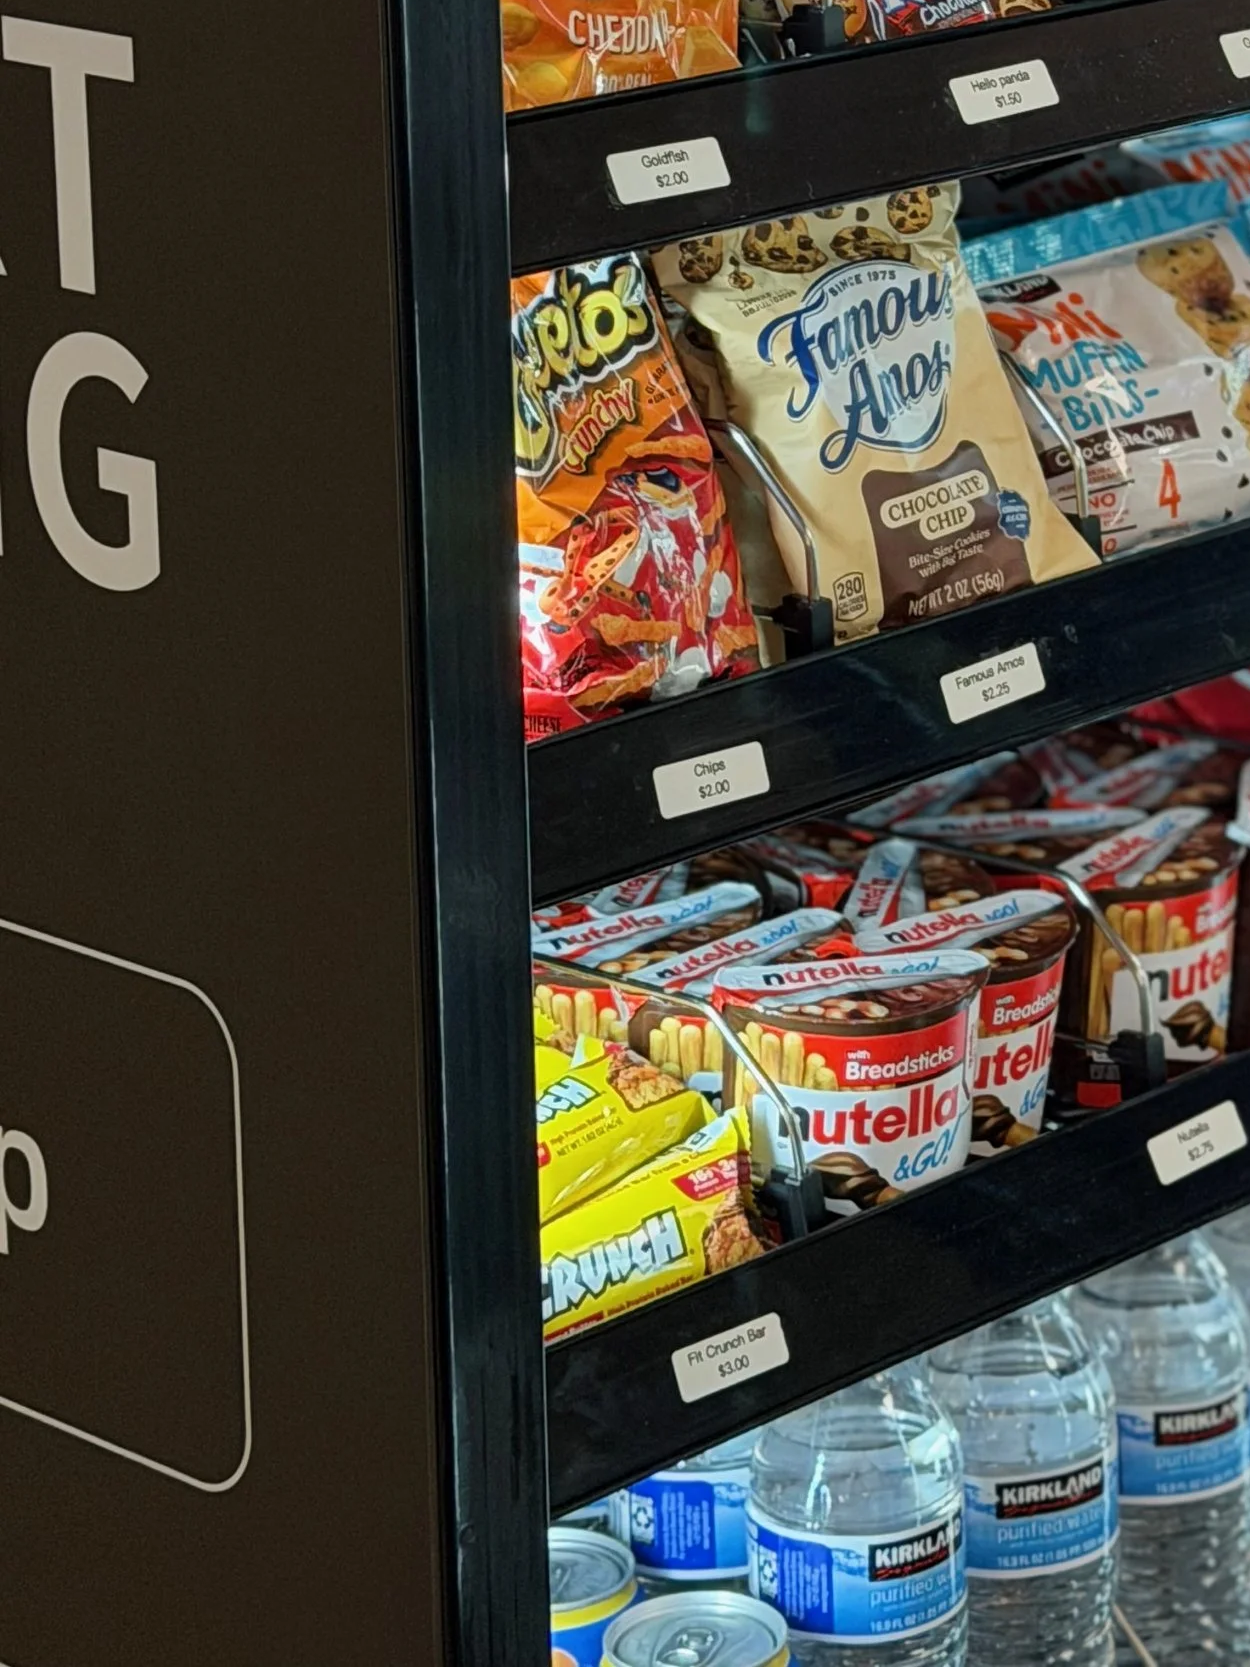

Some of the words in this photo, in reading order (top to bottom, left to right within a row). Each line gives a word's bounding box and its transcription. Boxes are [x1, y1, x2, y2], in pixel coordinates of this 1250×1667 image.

[970, 76, 998, 93] Hello
[999, 70, 1030, 89] panda
[995, 91, 1023, 107] $1.50
[0, 15, 134, 295] T
[641, 149, 690, 169] Goldfish
[656, 170, 689, 189] $2.00
[828, 274, 864, 297] SINCE
[866, 270, 897, 282] 1975
[757, 270, 955, 421] Famous
[819, 340, 953, 471] Amos
[1141, 424, 1175, 446] Chip
[0, 331, 161, 592] G
[888, 474, 984, 522] CHOCOLATE
[1158, 458, 1181, 518] 4
[926, 505, 968, 534] CHIP
[952, 529, 991, 551] Cookies
[919, 563, 942, 578] with
[958, 543, 985, 561] Taste
[836, 575, 863, 600] 280
[946, 587, 956, 602] 2
[956, 581, 972, 598] OZ
[971, 567, 1005, 597] (56g)
[955, 666, 994, 690] Famous
[997, 654, 1025, 675] Amos
[981, 681, 1011, 701] $2.25
[693, 758, 727, 778] Chips
[698, 780, 731, 799] $2.00
[550, 914, 665, 951] nutella
[885, 911, 984, 945] nutella
[655, 937, 759, 980] nutella
[762, 961, 884, 987] nutella
[1147, 948, 1230, 1003] nute
[845, 1045, 955, 1081] Breadsticks
[848, 1050, 871, 1060] with
[777, 1083, 960, 1146] nutella
[1188, 1140, 1215, 1162] $2.75
[687, 1350, 704, 1367] Fit
[705, 1335, 746, 1359] Crunch
[747, 1326, 767, 1341] Bar
[718, 1355, 750, 1378] $3.00
[1002, 1466, 1102, 1506] KIRKLAND
[997, 1518, 1063, 1544] purified
[870, 1576, 934, 1608] purified
